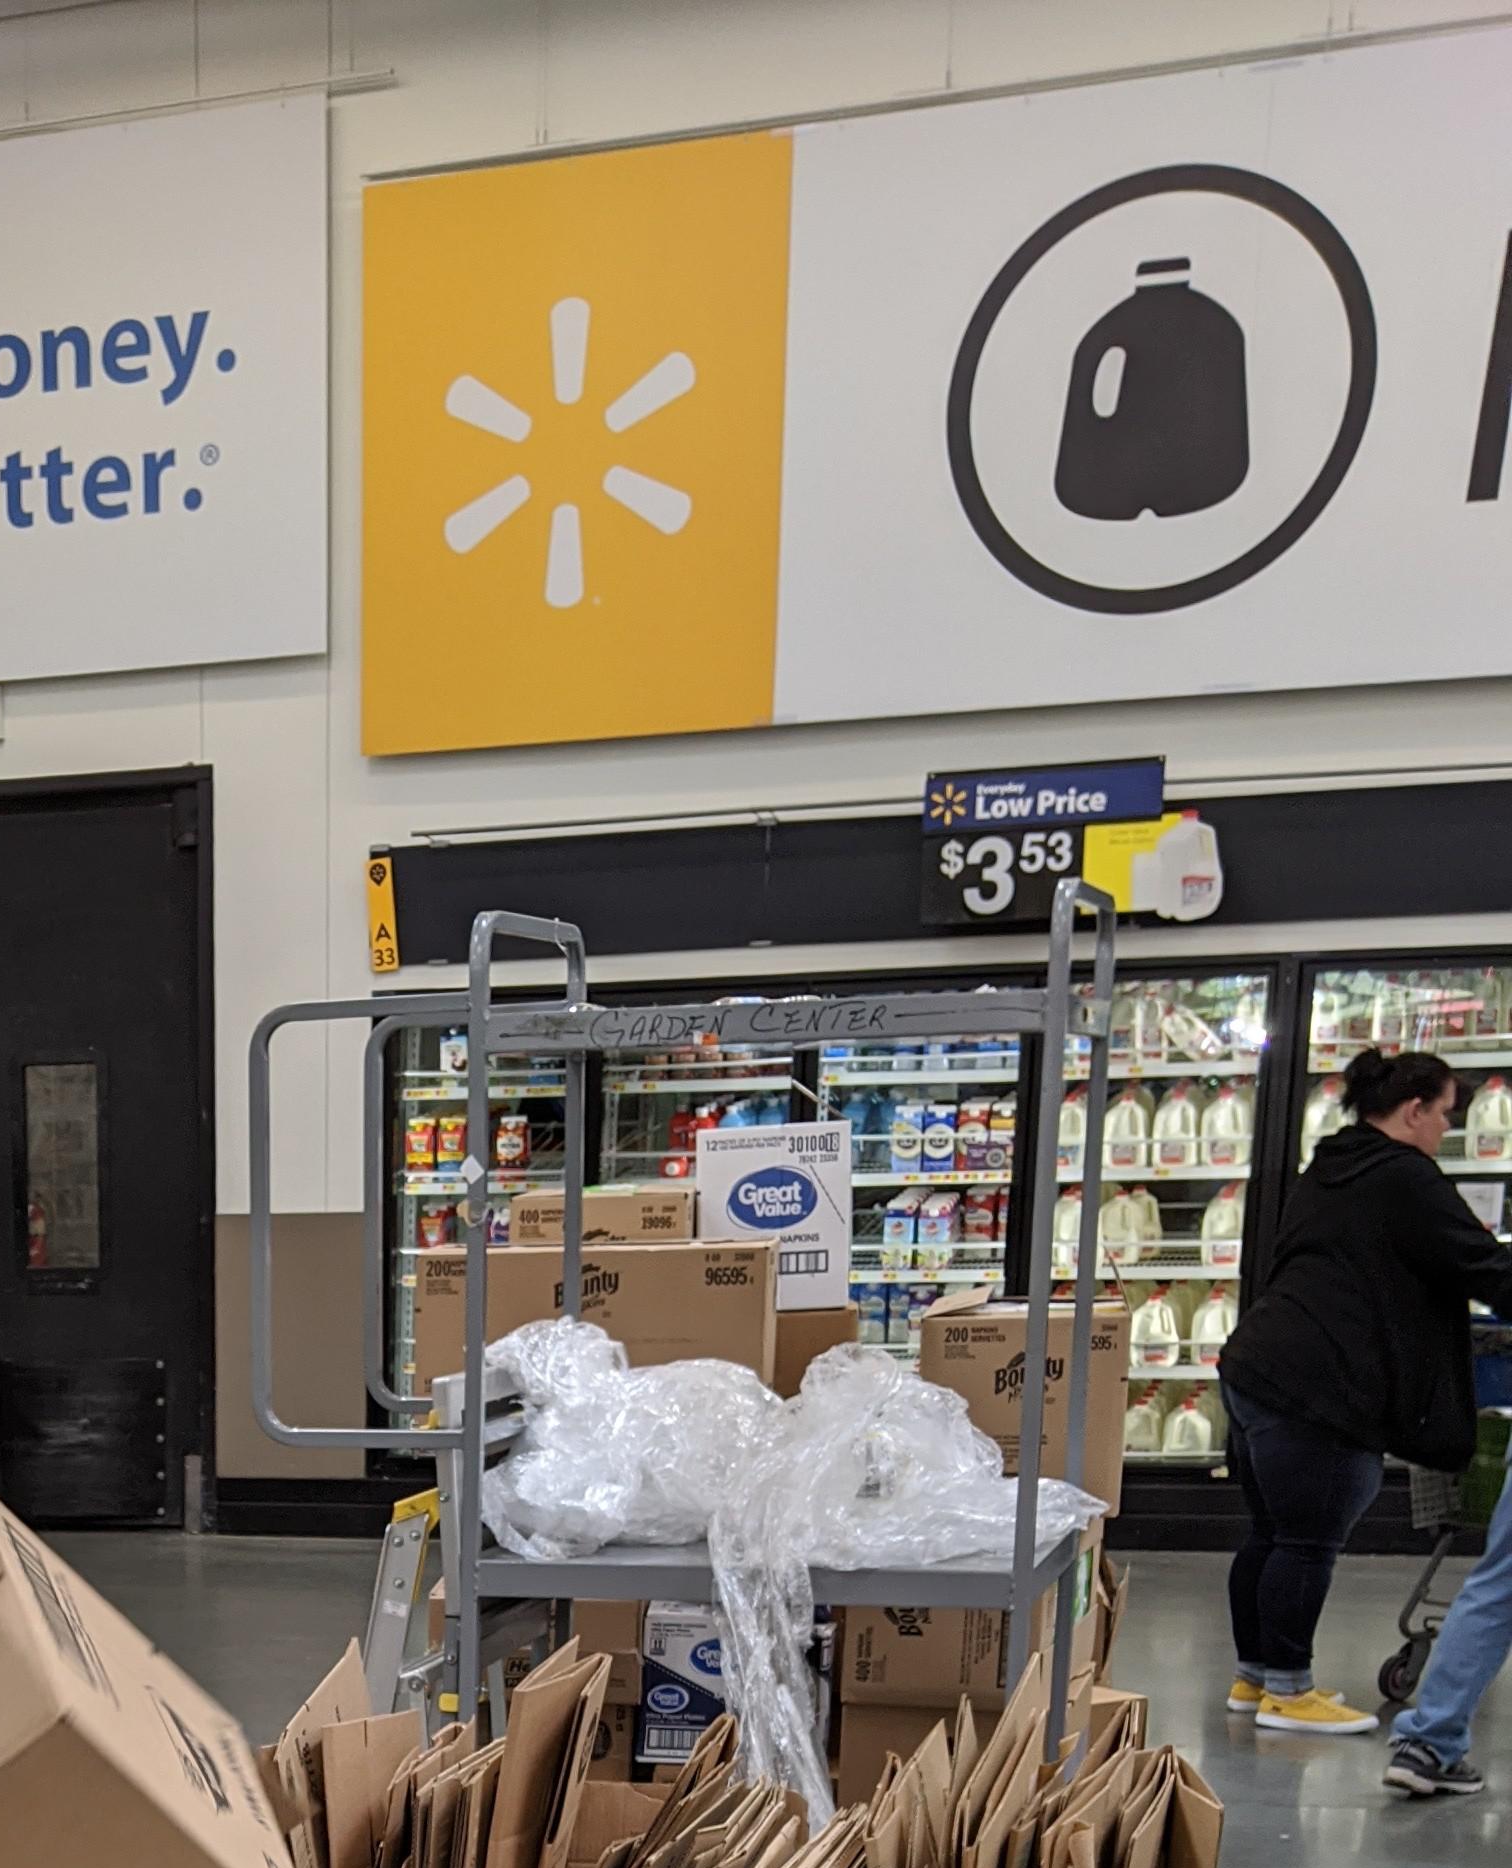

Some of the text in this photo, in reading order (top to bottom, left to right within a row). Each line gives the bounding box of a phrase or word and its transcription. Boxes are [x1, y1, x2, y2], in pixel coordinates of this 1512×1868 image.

[976, 782, 1025, 796] Everyday
[975, 787, 1107, 820] Low Price
[375, 922, 391, 942] A
[373, 949, 396, 968] 33
[591, 1003, 887, 1048] GARDEN CENTER
[705, 1141, 718, 1151] 12
[738, 1181, 802, 1205] Great
[754, 1203, 802, 1218] Value
[780, 1233, 820, 1244] NAPKINS
[426, 1260, 450, 1277] 200
[705, 1266, 748, 1286] 96595
[944, 1327, 968, 1343] 200
